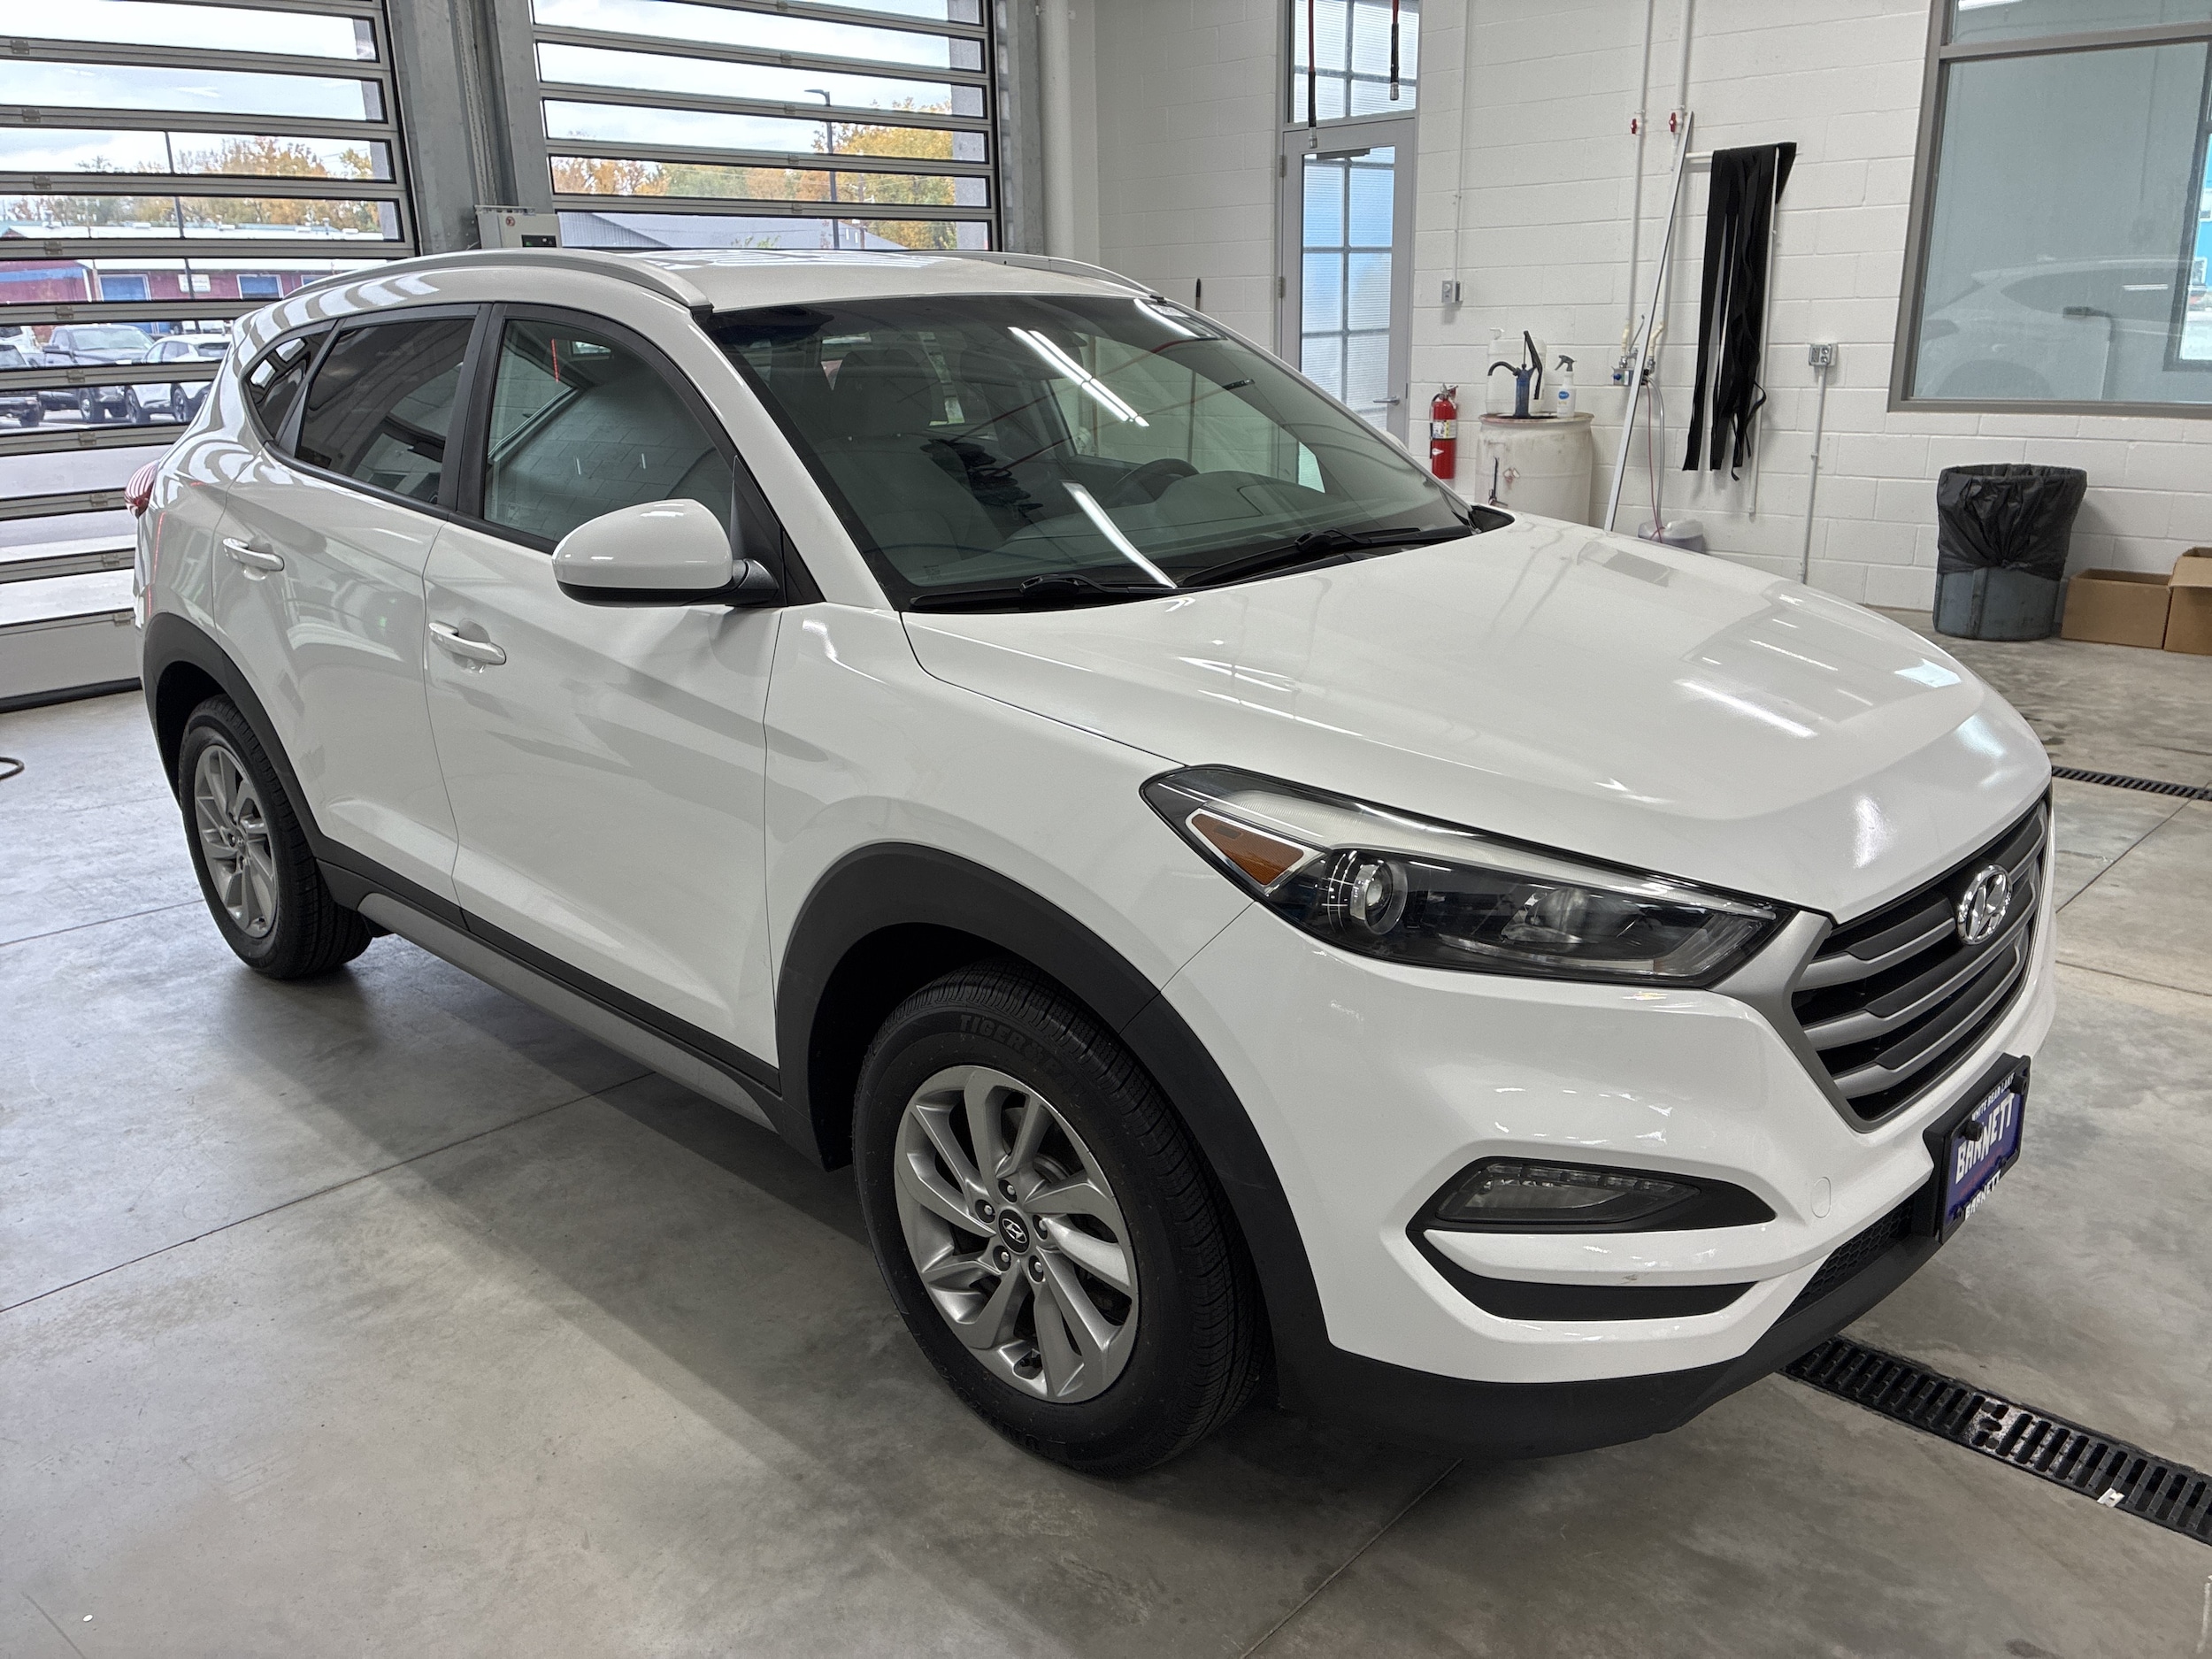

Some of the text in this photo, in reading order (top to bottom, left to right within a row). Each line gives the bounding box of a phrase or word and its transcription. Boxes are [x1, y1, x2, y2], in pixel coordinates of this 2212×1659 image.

[959, 1014, 1026, 1054] TIGER
[1987, 1082, 2001, 1109] BEAR
[1955, 1092, 2015, 1185] BARNETT
[1964, 1169, 2001, 1221] BARNETT
